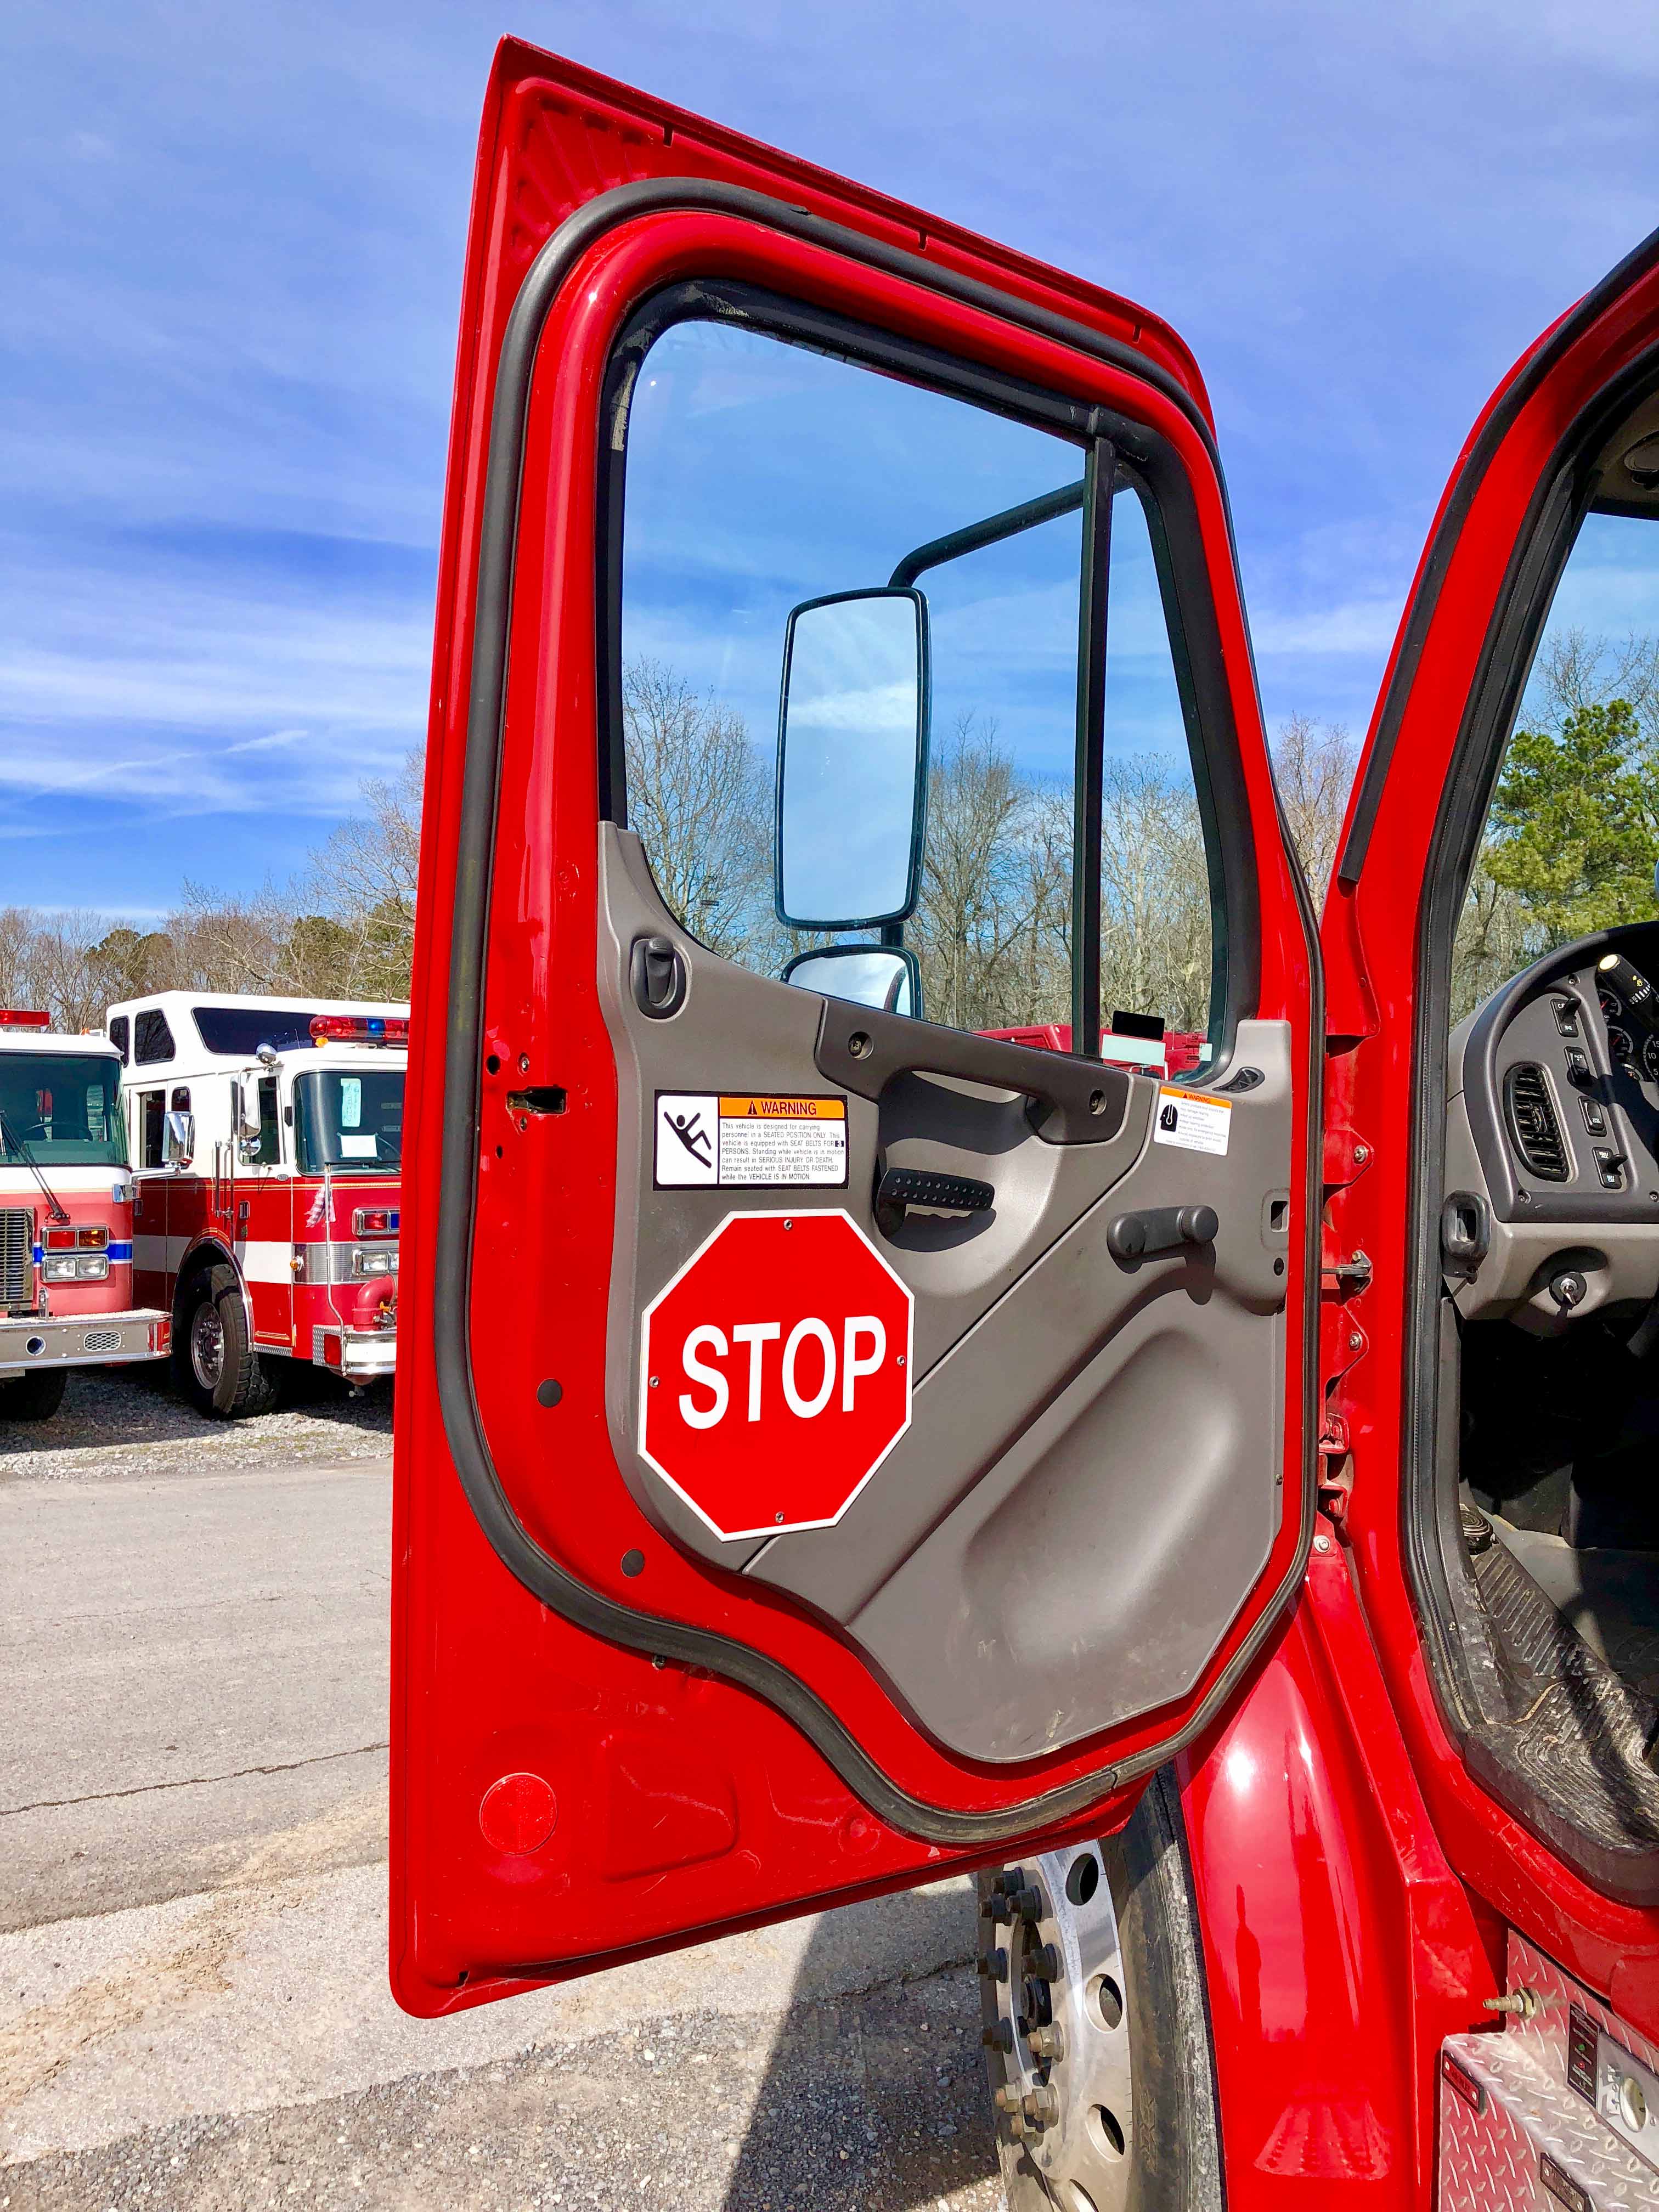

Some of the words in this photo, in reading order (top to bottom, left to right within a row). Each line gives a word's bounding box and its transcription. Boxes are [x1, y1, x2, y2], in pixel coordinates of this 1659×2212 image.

[1189, 1094, 1211, 1103] WARNING
[761, 1101, 817, 1115] WARNING
[679, 1315, 887, 1430] STOP
